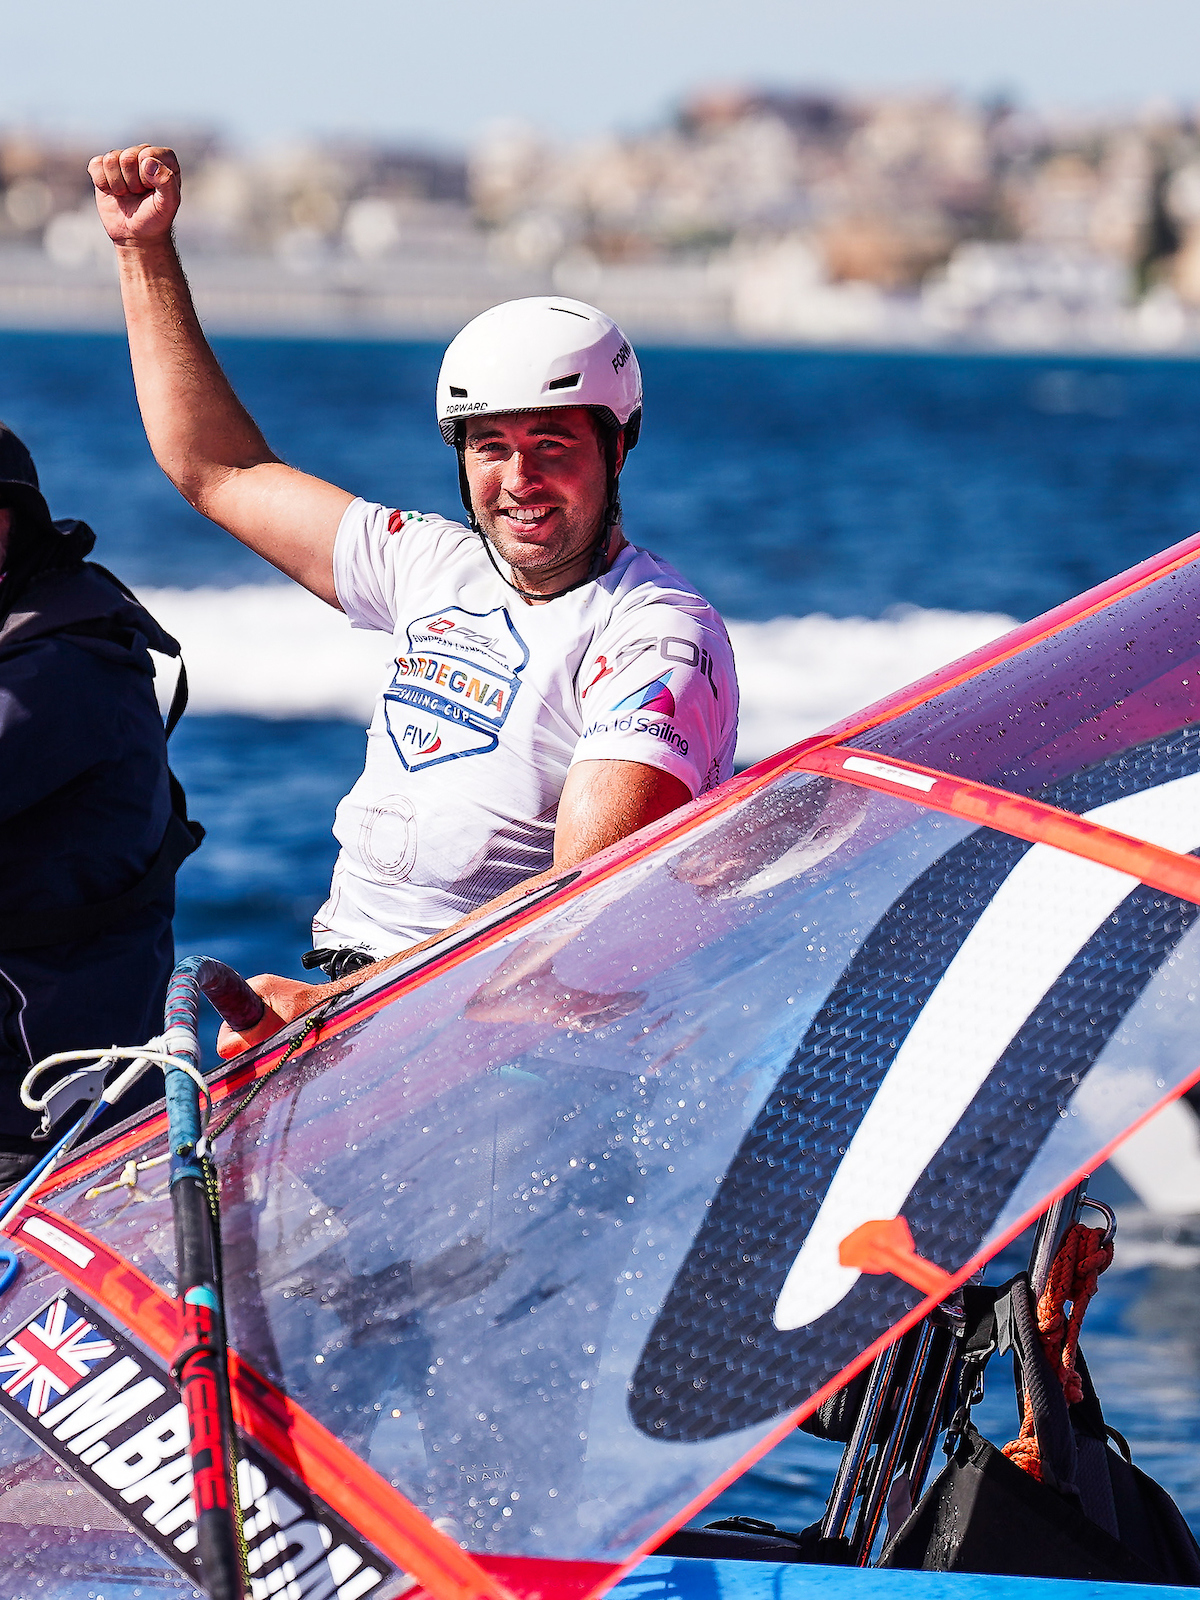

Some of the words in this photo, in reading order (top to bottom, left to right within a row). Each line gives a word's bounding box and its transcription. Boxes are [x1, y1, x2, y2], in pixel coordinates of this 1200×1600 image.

[398, 656, 505, 713] SARDEGNA
[398, 688, 439, 711] SAILING
[443, 704, 471, 723] CUP
[402, 723, 432, 749] FIV
[634, 717, 689, 756] Sailing
